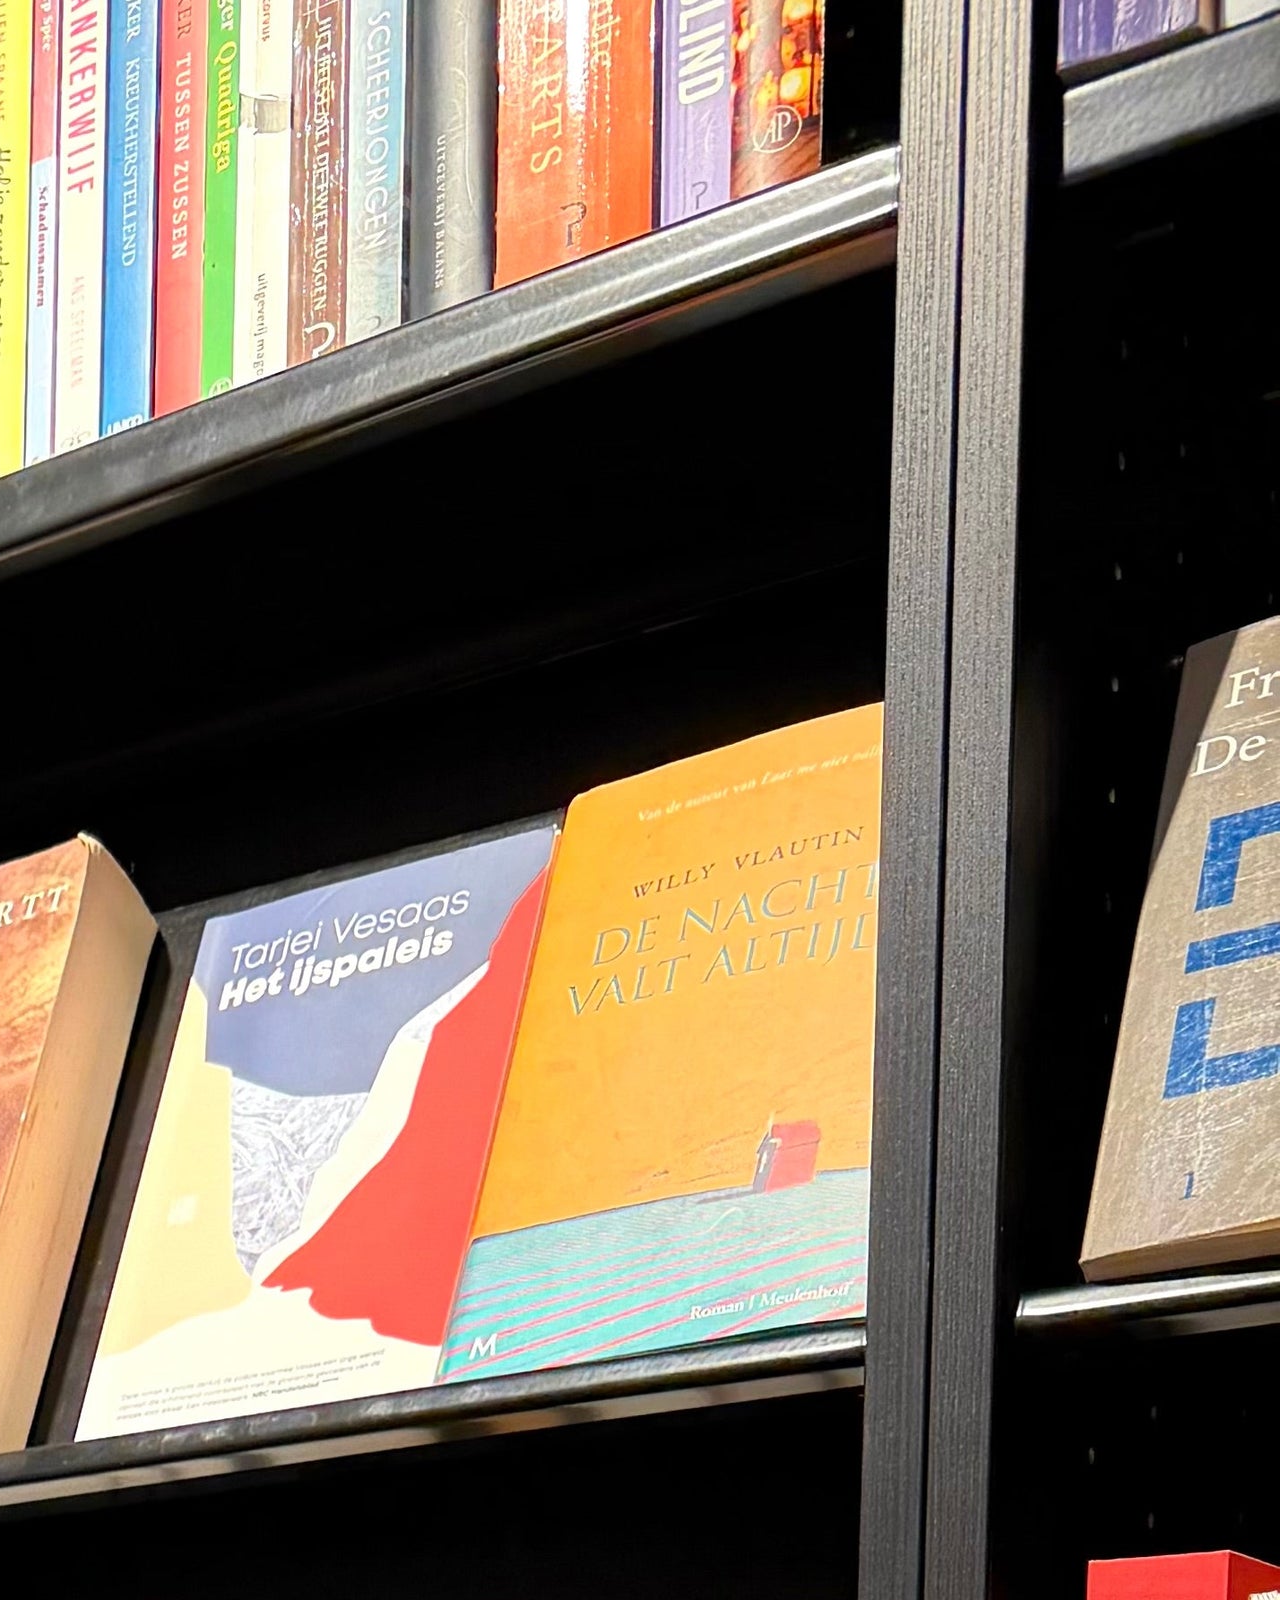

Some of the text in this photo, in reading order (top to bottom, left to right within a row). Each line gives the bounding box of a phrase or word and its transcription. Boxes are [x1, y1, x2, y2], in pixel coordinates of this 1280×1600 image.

[170, 52, 193, 261] TUSSEN ZUSSEN
[212, 40, 236, 174] Quadriga
[362, 10, 392, 252] SCHEERJONGEN
[120, 59, 141, 267] KREUKHERSTELLEND
[1190, 733, 1268, 778] De
[632, 825, 865, 899] WILLY VLAUTIN
[230, 886, 471, 978] Tarjei Vesaas
[590, 861, 880, 968] DE NACHT
[217, 926, 455, 1013] Het ijspaleis
[567, 953, 691, 1017] VALT
